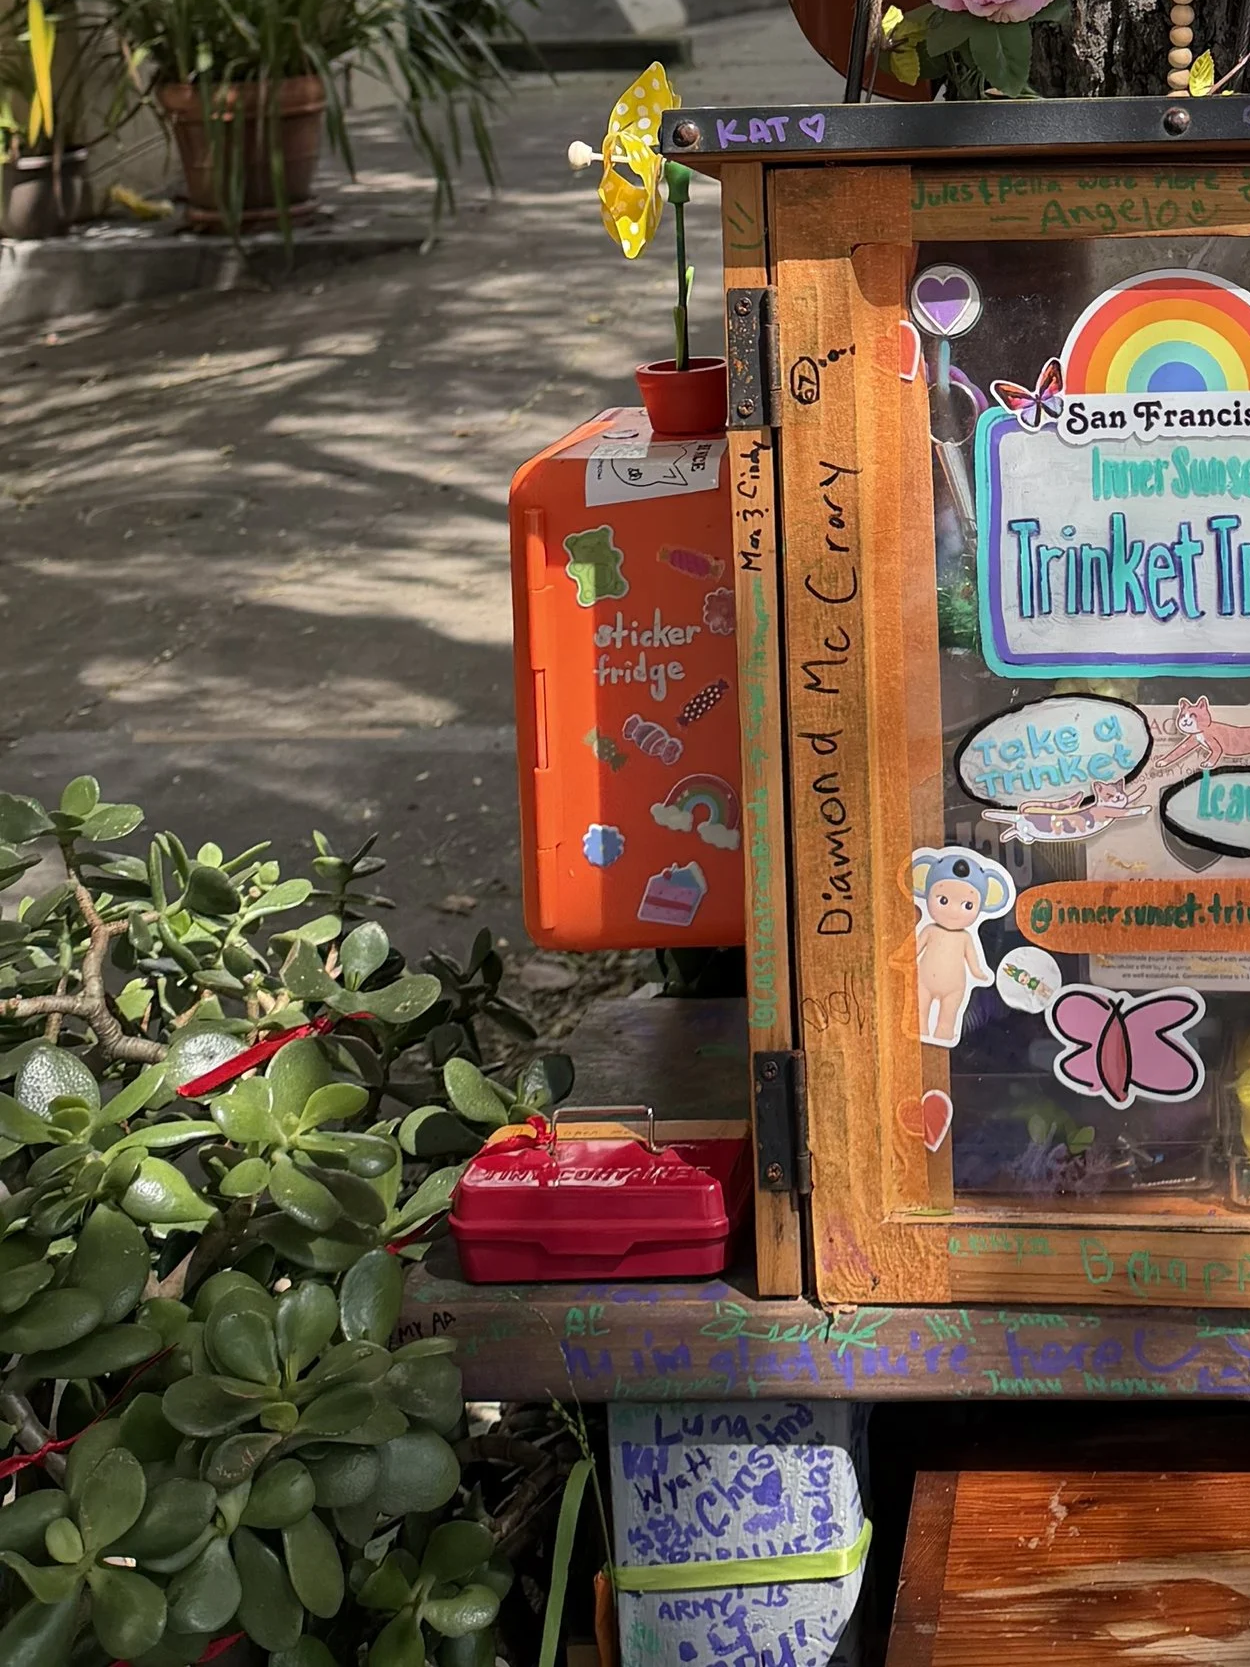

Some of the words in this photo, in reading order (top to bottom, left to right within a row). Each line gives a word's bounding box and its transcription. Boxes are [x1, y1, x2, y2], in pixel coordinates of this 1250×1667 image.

[715, 115, 790, 150] KAT
[1040, 198, 1181, 234] Angelo
[1065, 401, 1128, 435] San
[1090, 445, 1170, 502] Inner
[1007, 510, 1205, 623] Trinket
[593, 607, 700, 651] sticker
[594, 653, 686, 701] fridge
[974, 725, 1081, 764] Take
[1093, 714, 1123, 744] a
[973, 740, 1133, 796] Trinket
[799, 730, 856, 936] Diamond
[709, 1333, 818, 1390] glad
[1004, 1328, 1124, 1379] here
